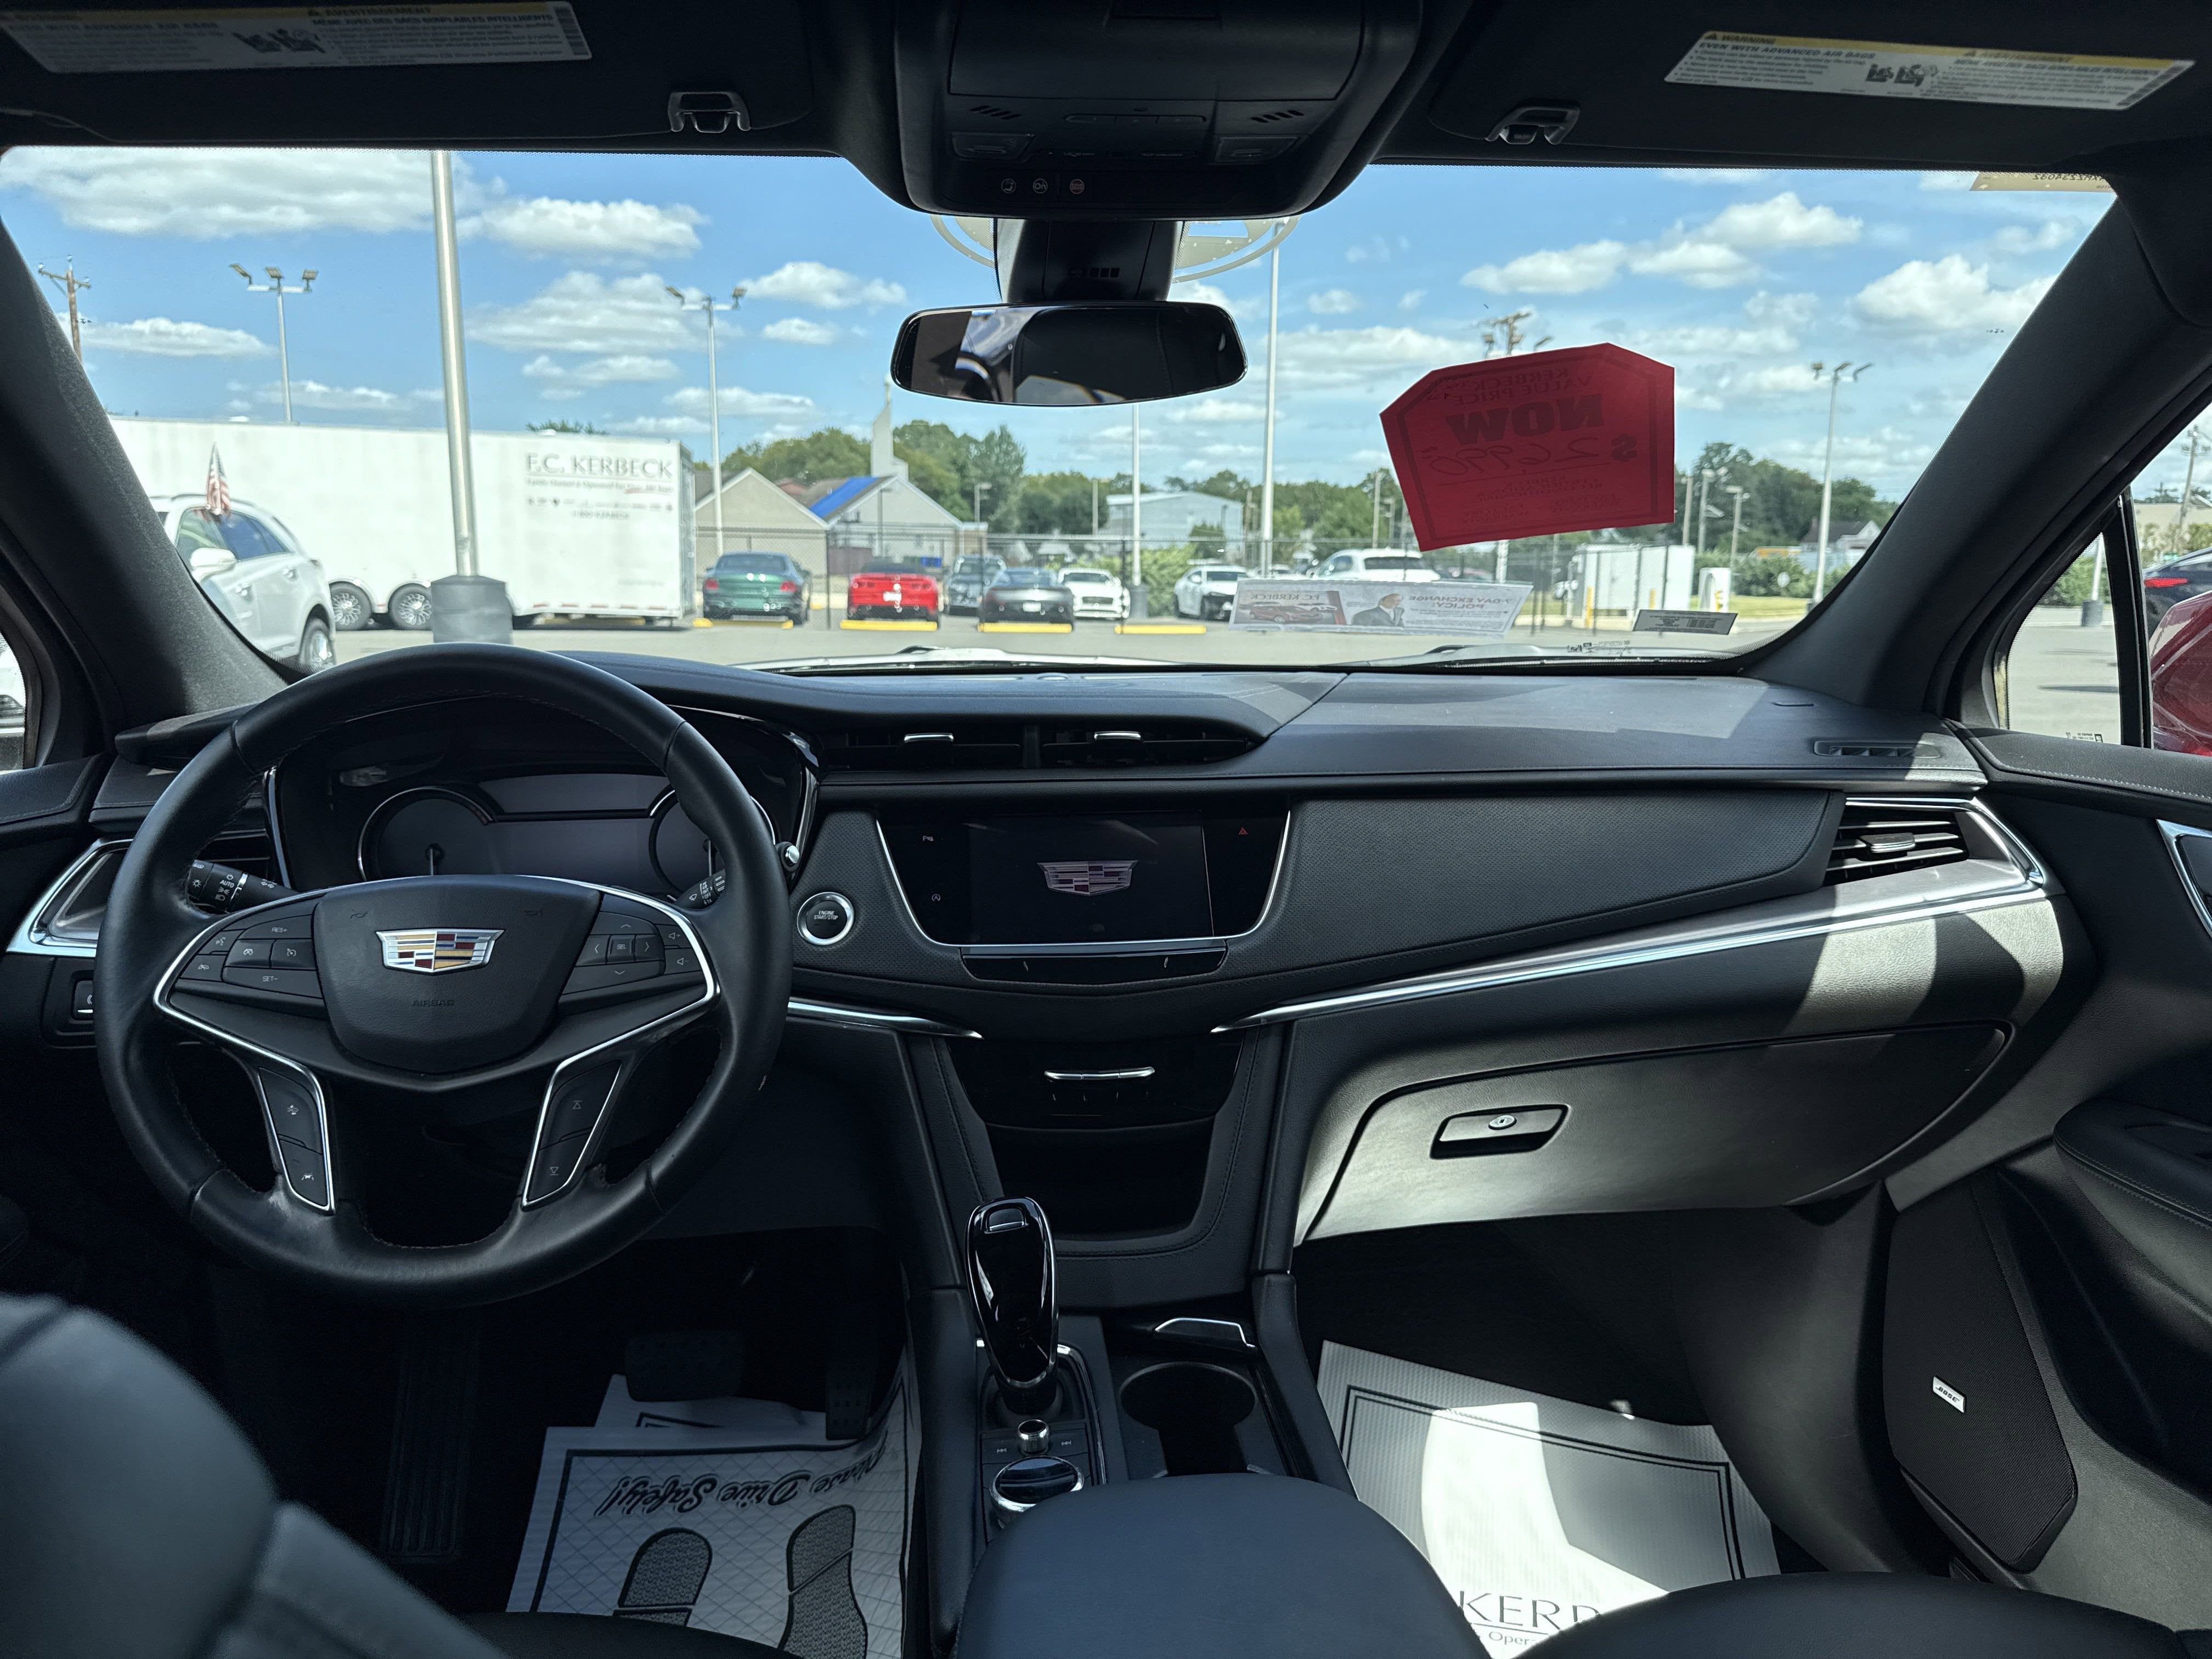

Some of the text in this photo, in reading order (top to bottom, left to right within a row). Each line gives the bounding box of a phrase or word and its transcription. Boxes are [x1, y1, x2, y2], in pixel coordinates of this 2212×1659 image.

[1722, 35, 1776, 44] WARNING
[1762, 46, 1821, 55] ADVANCED
[526, 452, 672, 478] F.C. KERBECK
[219, 879, 235, 888] AUTO
[1936, 1386, 1960, 1402] BOSE
[594, 1472, 719, 1516] Safely!
[717, 1470, 812, 1509] Drive
